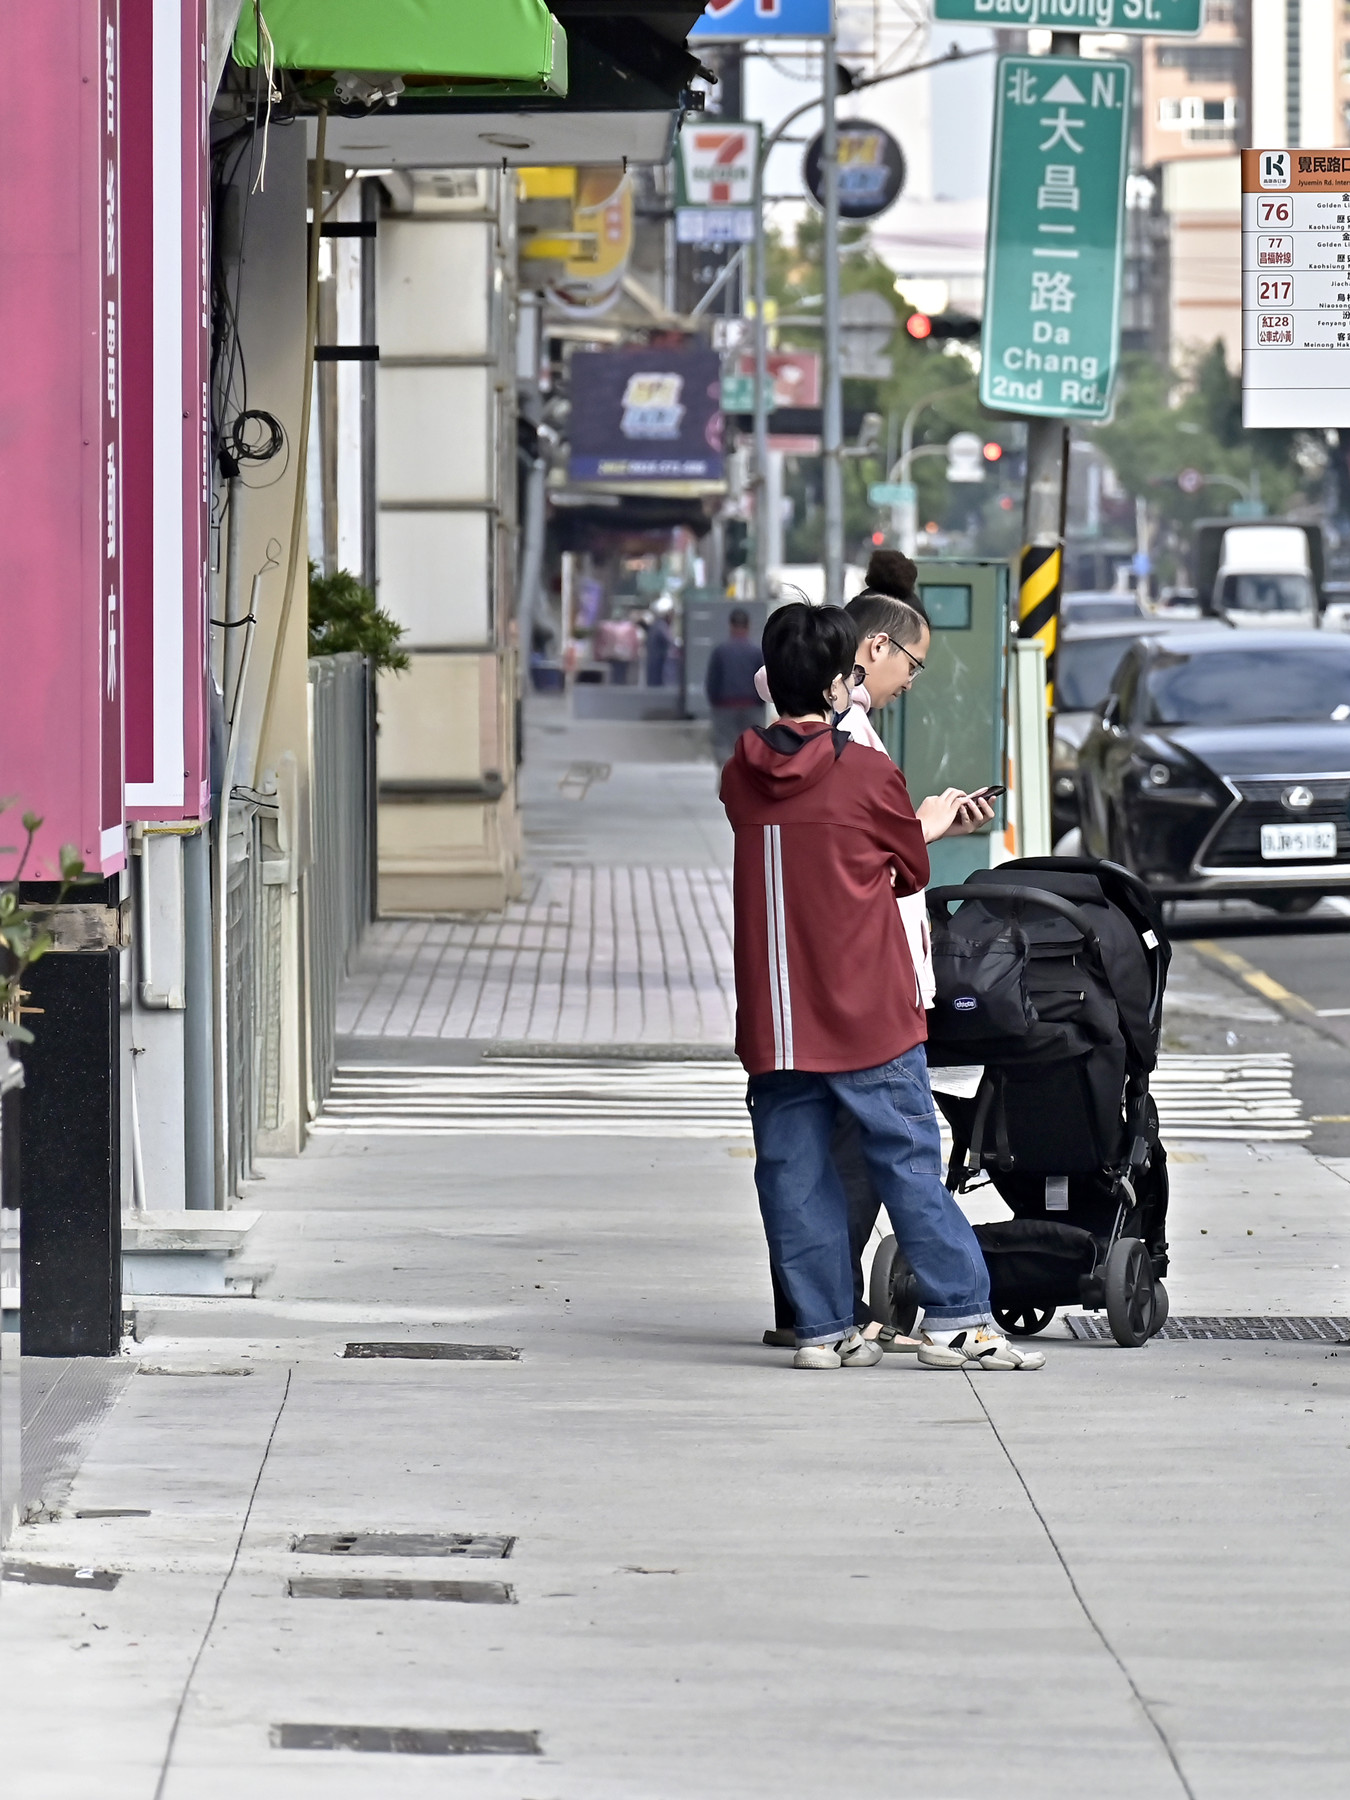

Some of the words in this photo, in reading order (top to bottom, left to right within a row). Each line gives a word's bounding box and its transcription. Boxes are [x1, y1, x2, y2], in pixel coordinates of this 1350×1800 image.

[1123, 0, 1161, 20] St.
[1006, 68, 1038, 105] 北
[1091, 72, 1121, 108] N.
[1298, 179, 1323, 187] Jyuemin
[1030, 107, 1086, 313] 大昌二路
[1262, 203, 1289, 221] 76
[1268, 238, 1283, 249] 77
[1260, 282, 1291, 300] 217
[1262, 316, 1289, 328] 紅28
[1033, 321, 1070, 346] Da
[1259, 330, 1292, 343] 公車式小黃
[1003, 347, 1098, 379] Chang
[992, 376, 1043, 401] 2nd
[1061, 380, 1102, 406] Rd.
